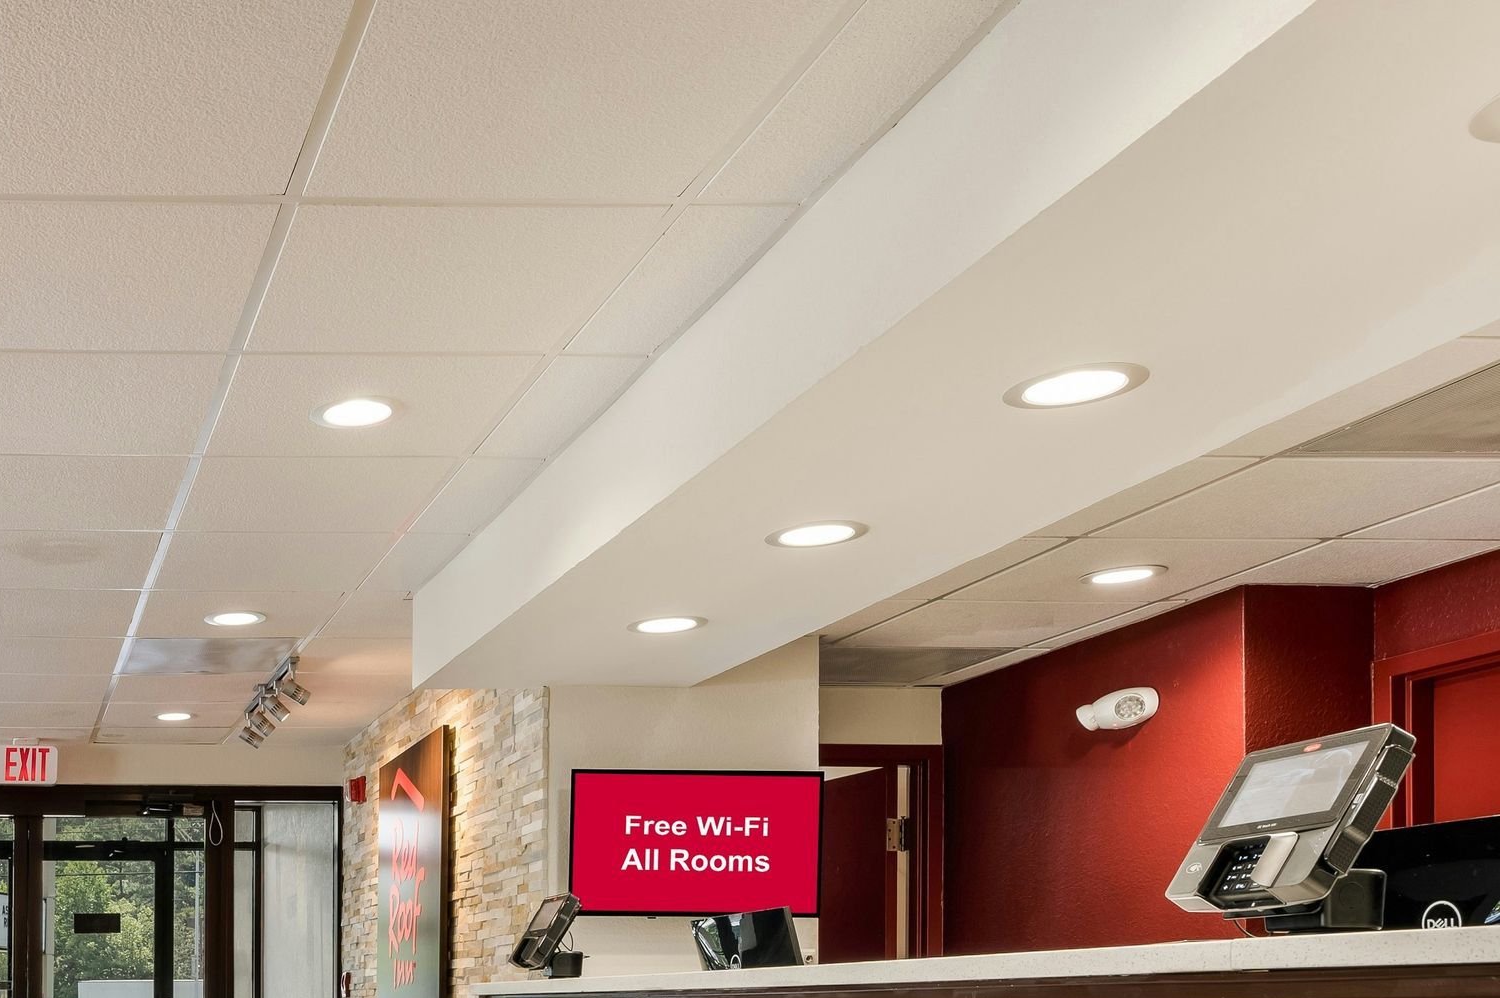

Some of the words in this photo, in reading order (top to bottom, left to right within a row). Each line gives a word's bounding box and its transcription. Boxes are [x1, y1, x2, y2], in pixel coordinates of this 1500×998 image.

[5, 748, 49, 781] EXIT
[625, 815, 687, 836] Free
[696, 816, 769, 837] Wi-Fi
[391, 817, 420, 885] Red
[621, 848, 659, 871] All
[670, 849, 770, 872] Rooms
[389, 867, 425, 958] Roof
